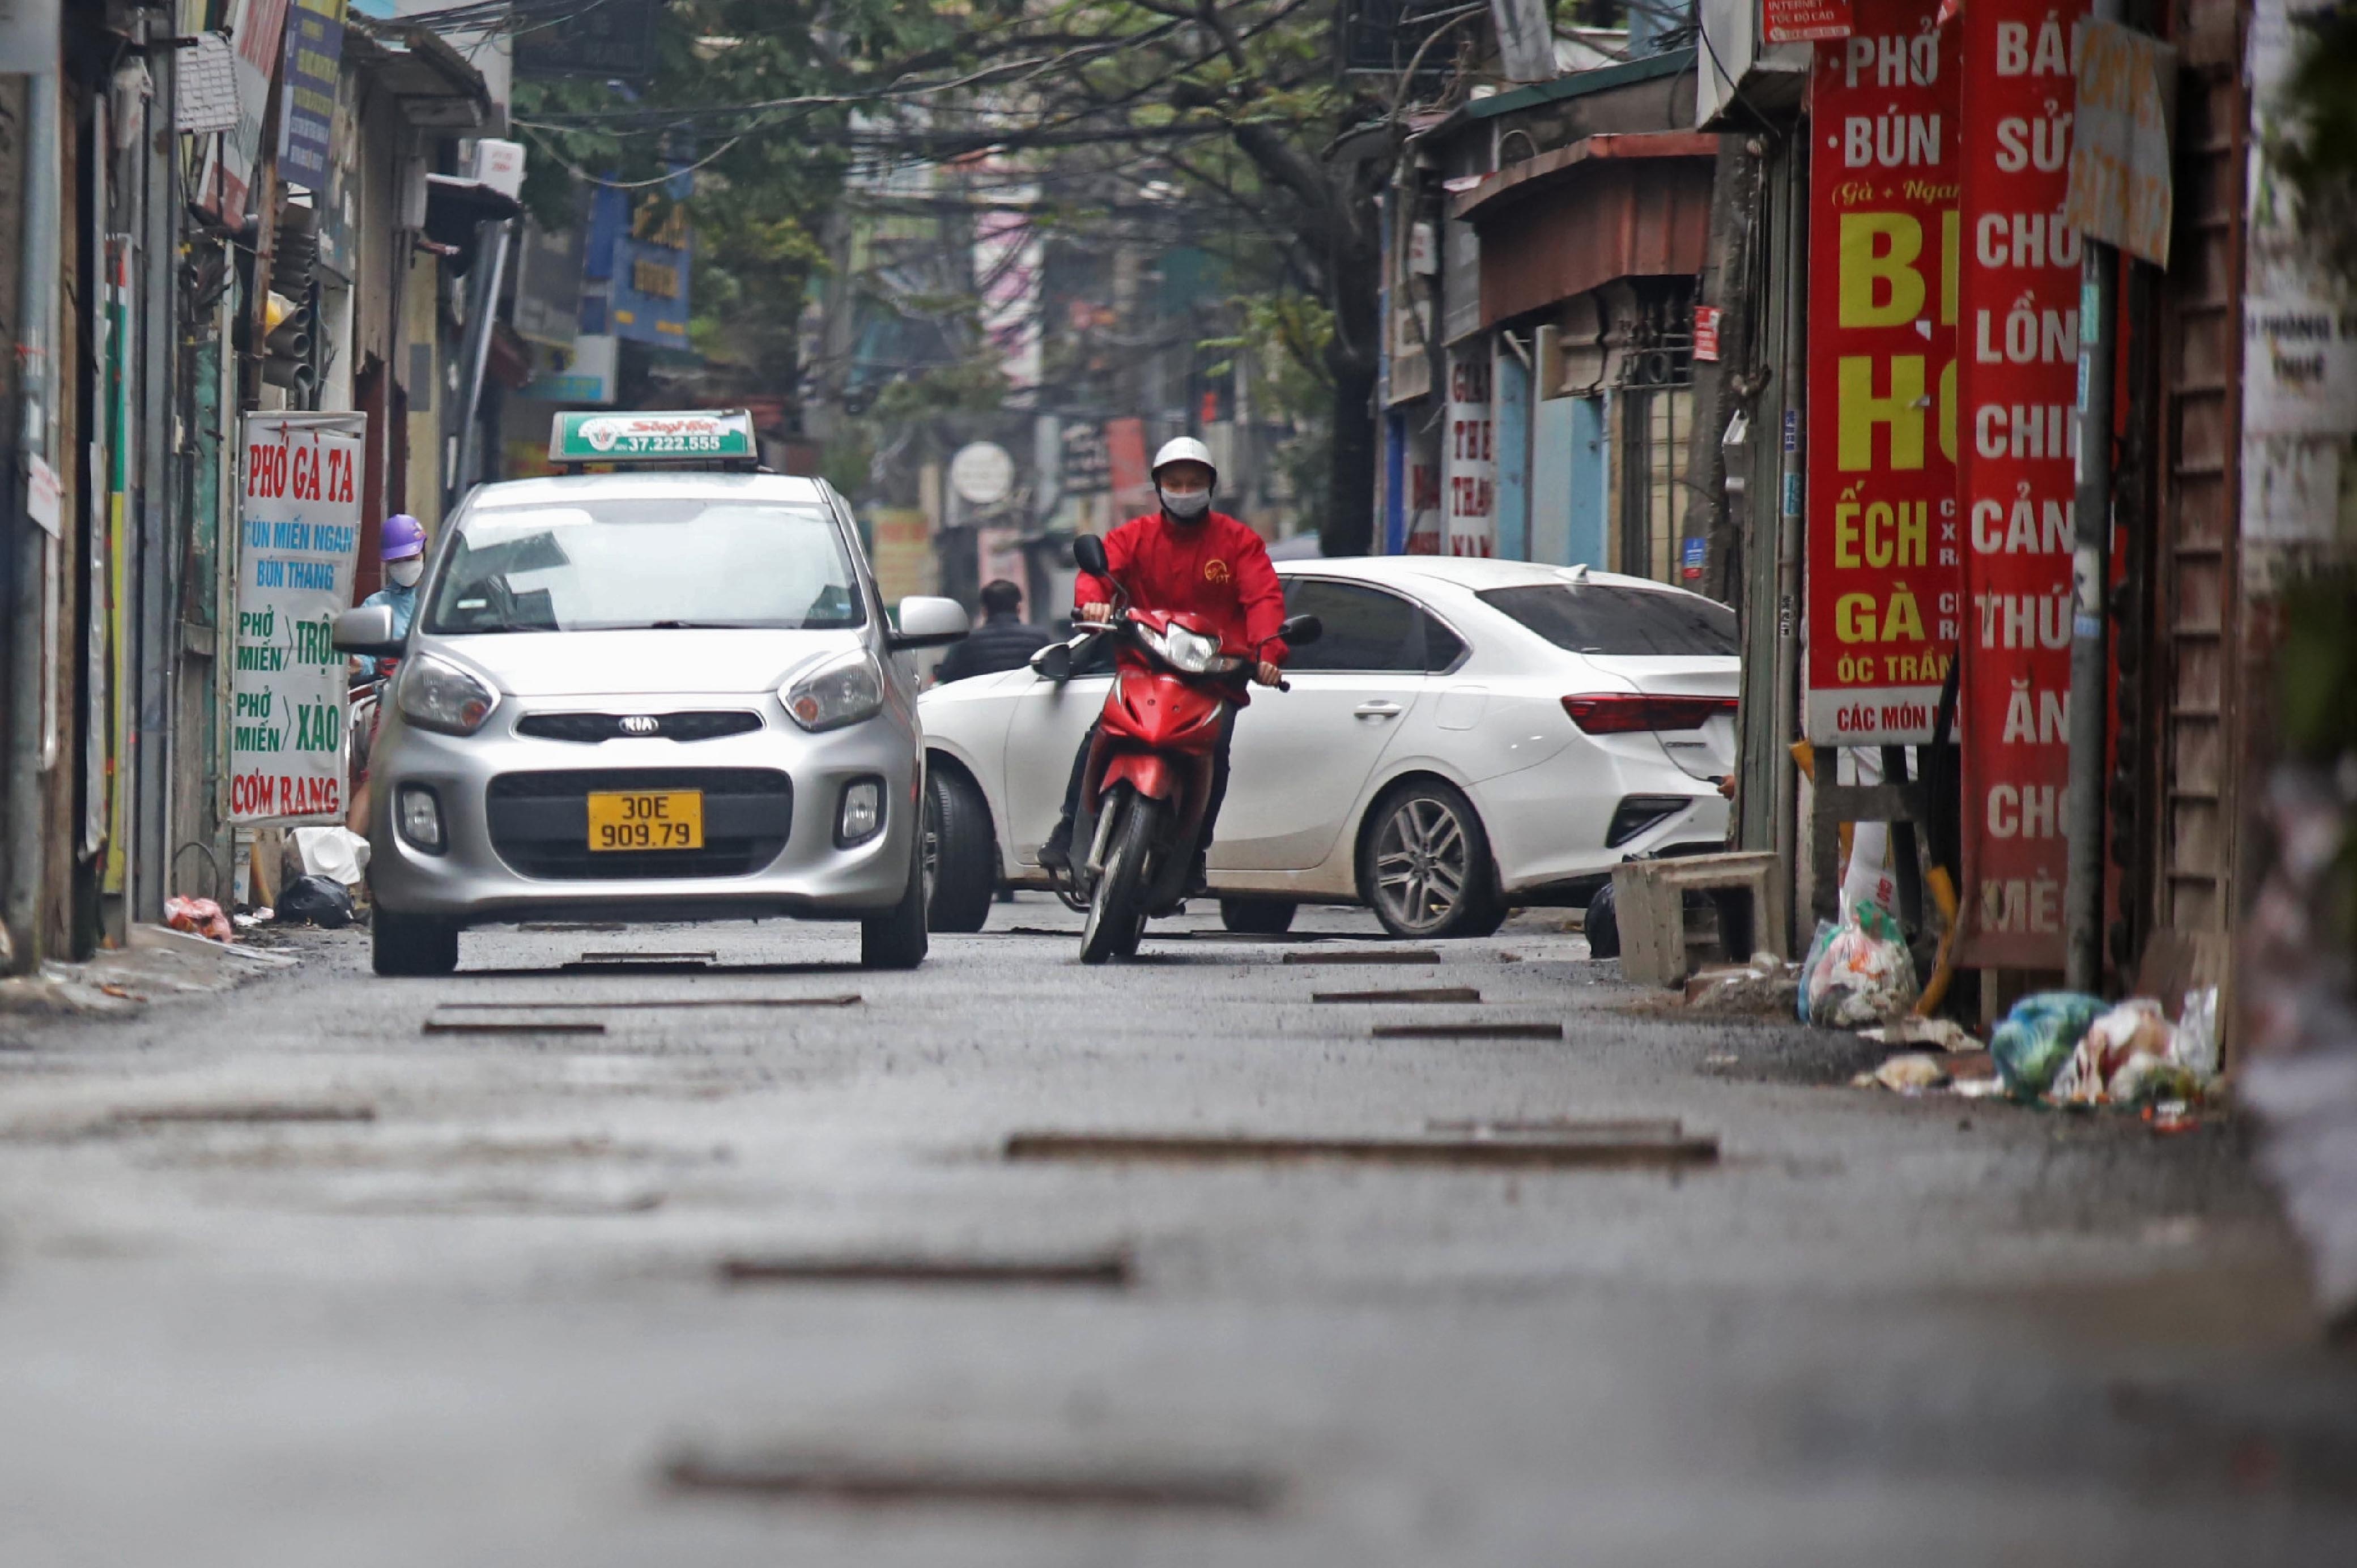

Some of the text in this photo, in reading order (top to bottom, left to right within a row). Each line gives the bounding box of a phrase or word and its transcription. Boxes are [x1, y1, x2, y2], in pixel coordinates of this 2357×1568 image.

[1846, 15, 1941, 87] PHỞ
[1845, 103, 1941, 168] BÚN
[1838, 355, 1957, 472] H
[628, 436, 720, 451] 37.222.555
[247, 421, 354, 503] PHỞ GÀ TA
[274, 514, 310, 550] MIẾN
[1835, 480, 1928, 569] ẾCH
[1971, 480, 2075, 554] CẢN
[256, 555, 335, 591] BÚN THANG
[238, 604, 274, 637] PHỞ
[1836, 581, 1926, 644] GÀ
[1939, 593, 1959, 613] C
[1939, 620, 1959, 640] R
[237, 639, 282, 671] MIẾN
[236, 685, 272, 718] PHỞ
[1837, 702, 1875, 731] CÁC
[1881, 700, 1926, 730] MÓN
[2003, 678, 2071, 743] ĂN
[234, 720, 280, 752] MIẾN
[295, 694, 339, 753] XÀO
[626, 717, 652, 731] KIA
[279, 776, 339, 816] RANG
[622, 796, 669, 819] 30E
[601, 823, 690, 846] 909.79
[1981, 867, 2068, 934] MÈ
